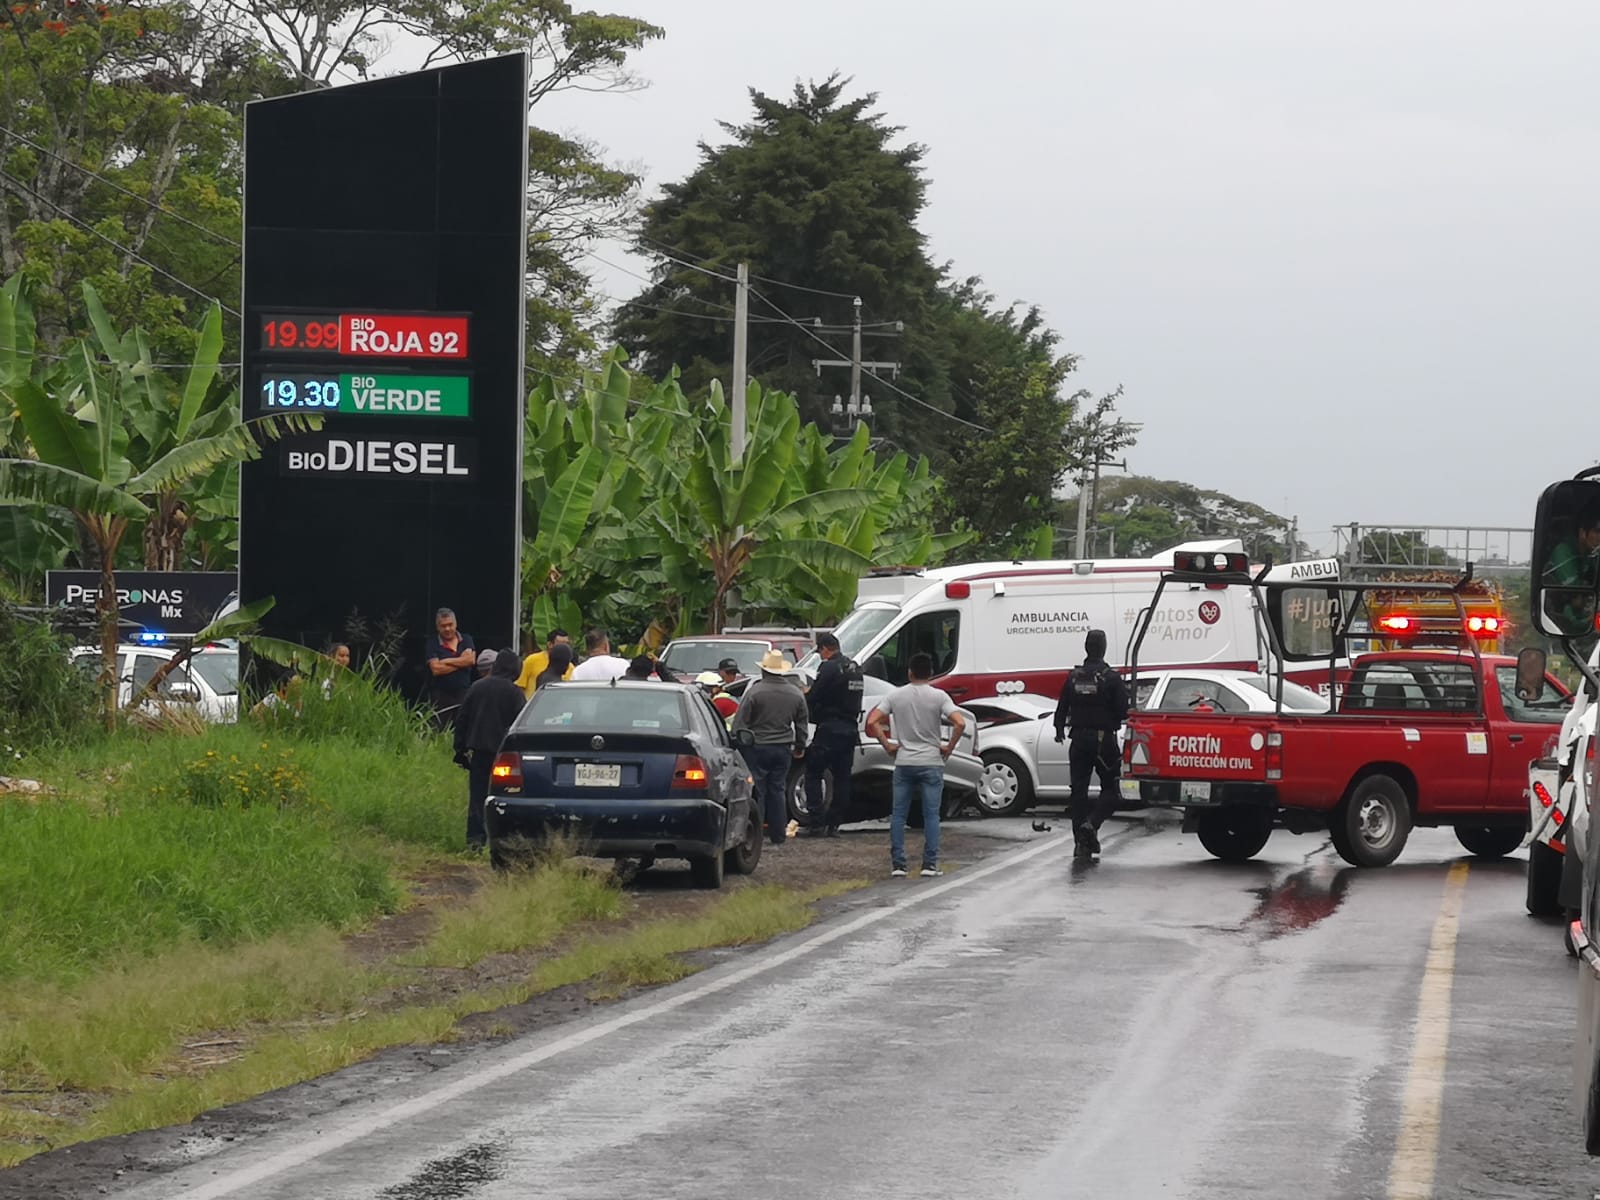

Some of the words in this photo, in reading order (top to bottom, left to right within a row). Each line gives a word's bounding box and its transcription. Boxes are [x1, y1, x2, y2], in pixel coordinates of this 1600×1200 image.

[350, 318, 376, 331] BIO
[264, 321, 339, 347] 19.99
[351, 331, 423, 353] ROJA
[428, 331, 460, 354] 92
[350, 376, 377, 389] BIO
[263, 380, 340, 407] 19.30
[351, 389, 441, 411] VERDE
[1011, 611, 1089, 623] AMBULANCIA
[1123, 608, 1195, 624] #ntos
[1006, 626, 1055, 635] URGENCIAS
[1056, 625, 1092, 634] BASICAS
[1162, 624, 1213, 641] Amor
[1168, 733, 1221, 753] FORTÍN
[1169, 756, 1227, 769] PROTECCIÓN
[1229, 757, 1254, 770] CIVIL
